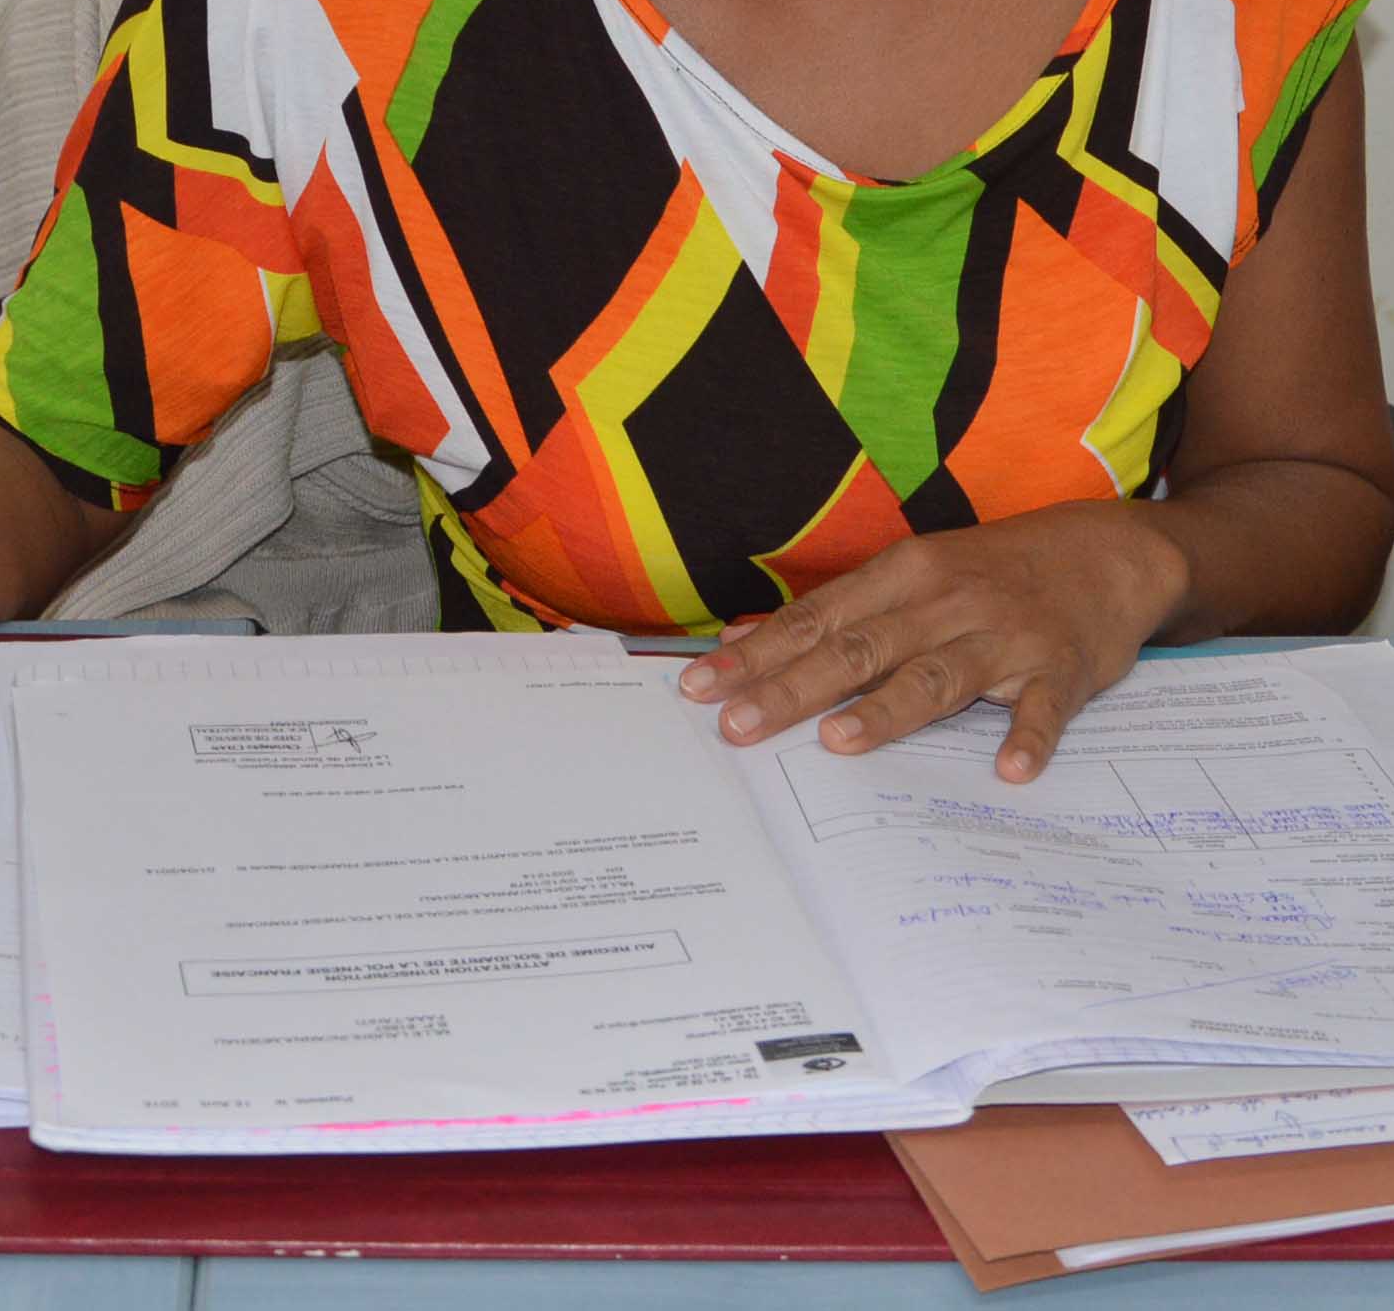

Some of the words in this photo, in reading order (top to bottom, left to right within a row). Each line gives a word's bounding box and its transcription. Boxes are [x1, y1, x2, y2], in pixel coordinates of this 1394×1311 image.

[633, 943, 655, 952] AU
[546, 951, 566, 960] DE
[397, 961, 418, 970] LA
[423, 959, 444, 968] DE
[443, 960, 551, 975] ATTESTATION
[324, 968, 439, 982] D'INSCRIPTION
